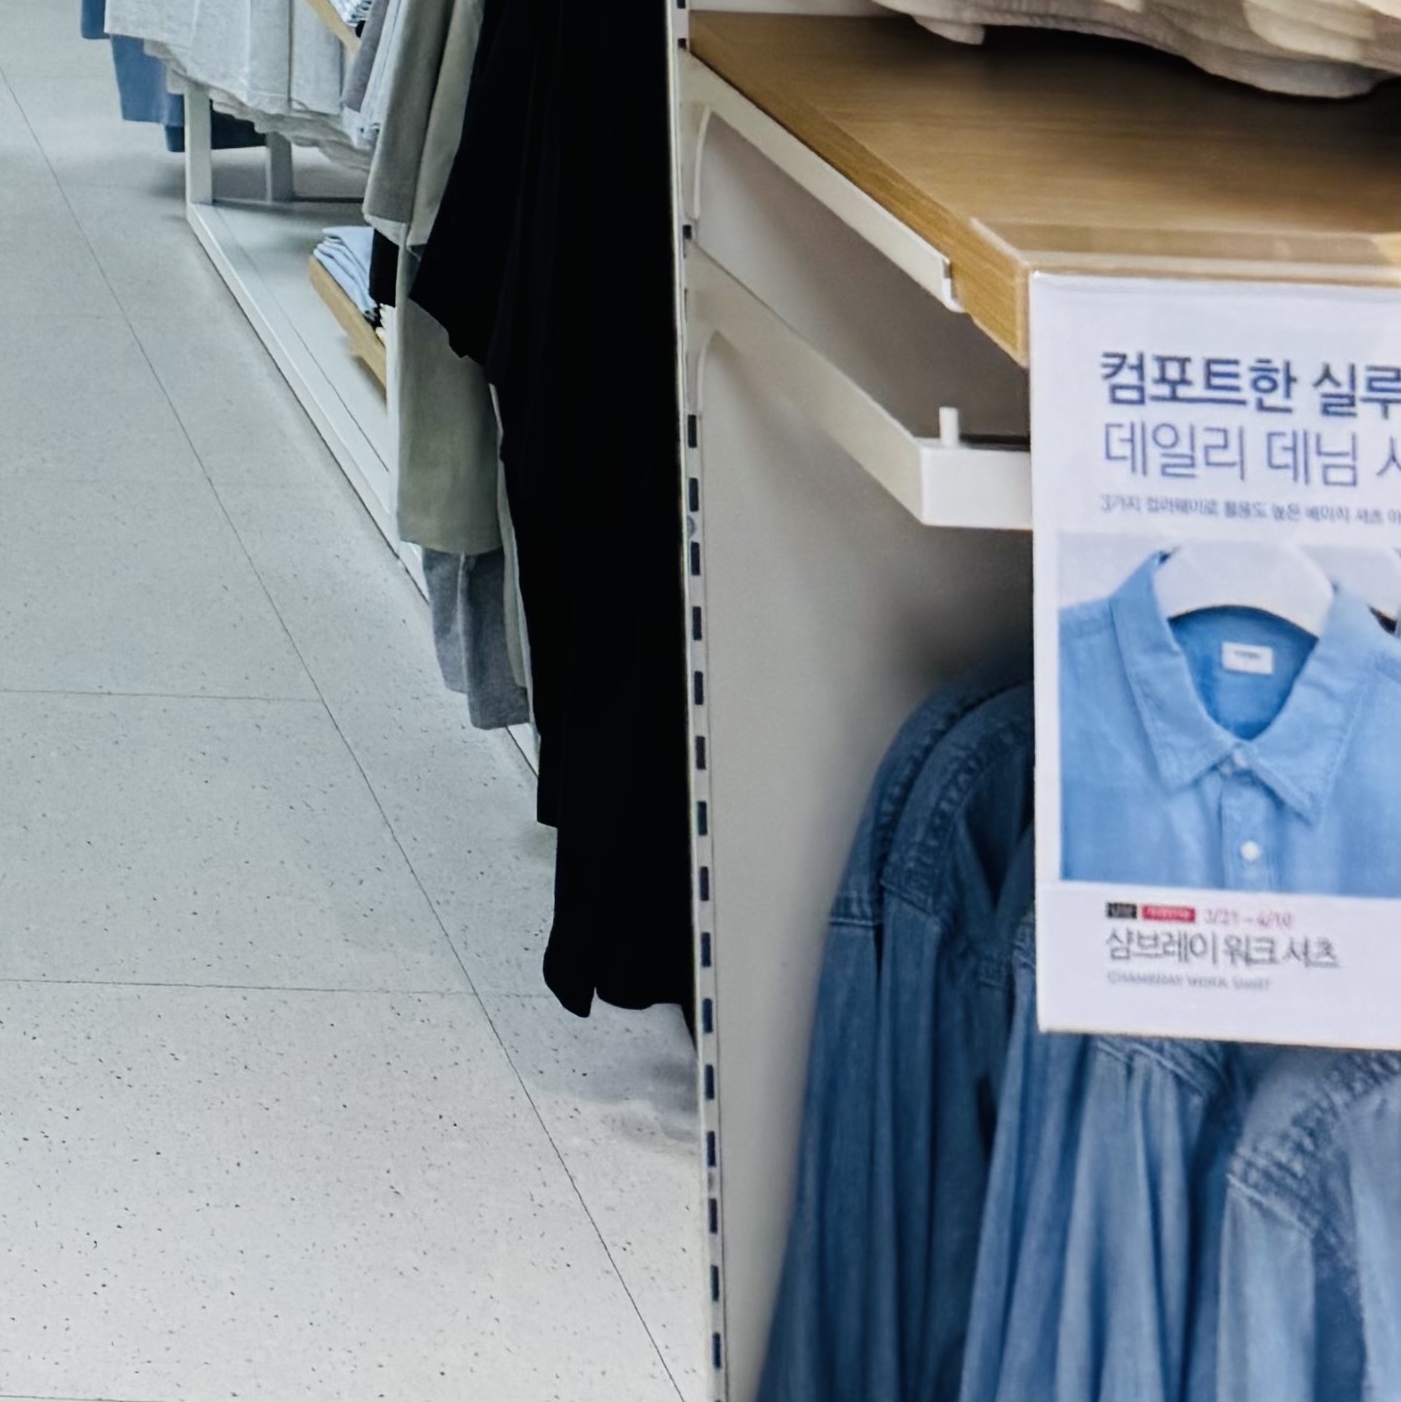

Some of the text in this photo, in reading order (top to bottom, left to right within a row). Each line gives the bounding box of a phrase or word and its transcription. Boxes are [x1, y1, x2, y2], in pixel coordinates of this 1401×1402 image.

[1101, 351, 1298, 414] 컴포트한
[1104, 421, 1246, 482] 데일리
[1266, 429, 1358, 488] 데님
[1106, 927, 1218, 965] 샴브레이
[1282, 935, 1342, 969] 셔츠
